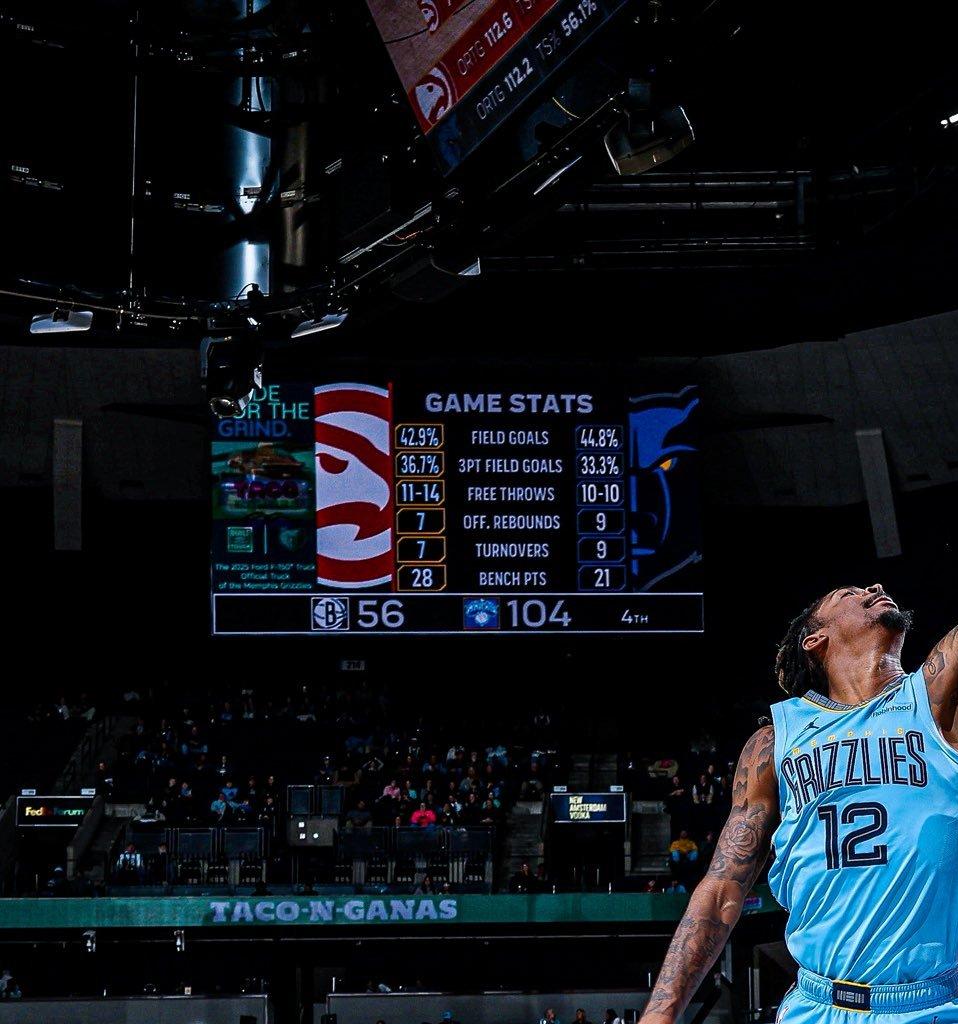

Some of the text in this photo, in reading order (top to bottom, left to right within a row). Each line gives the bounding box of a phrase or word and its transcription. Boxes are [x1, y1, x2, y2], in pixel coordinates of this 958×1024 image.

[457, 12, 513, 75] ORTG 112.6
[476, 85, 505, 120] ORTG
[504, 57, 533, 92] 112.2
[561, 0, 598, 37] 56.1%
[253, 385, 280, 401] DE
[425, 393, 593, 413] GAME STATS
[267, 402, 310, 420] THE
[400, 427, 619, 448] 42.9% FIELD GOALS 44.8%
[400, 455, 619, 475] 36.7% 3PT FIELD GOALS 33.3%
[401, 483, 620, 502] 11-14 FREE THROWS 10-10
[416, 512, 607, 531] 7 OFF. REBOUNDS 9
[416, 541, 607, 559] 7 TURNOVERS 9
[411, 568, 610, 588] 28 BENCH PTS 21
[357, 600, 404, 628] 56
[506, 600, 572, 627] 104
[620, 609, 649, 624] 4TH
[781, 730, 928, 814] GRIZZLIES
[817, 801, 888, 870] 12
[210, 900, 458, 923] TACO-N-GANAS
